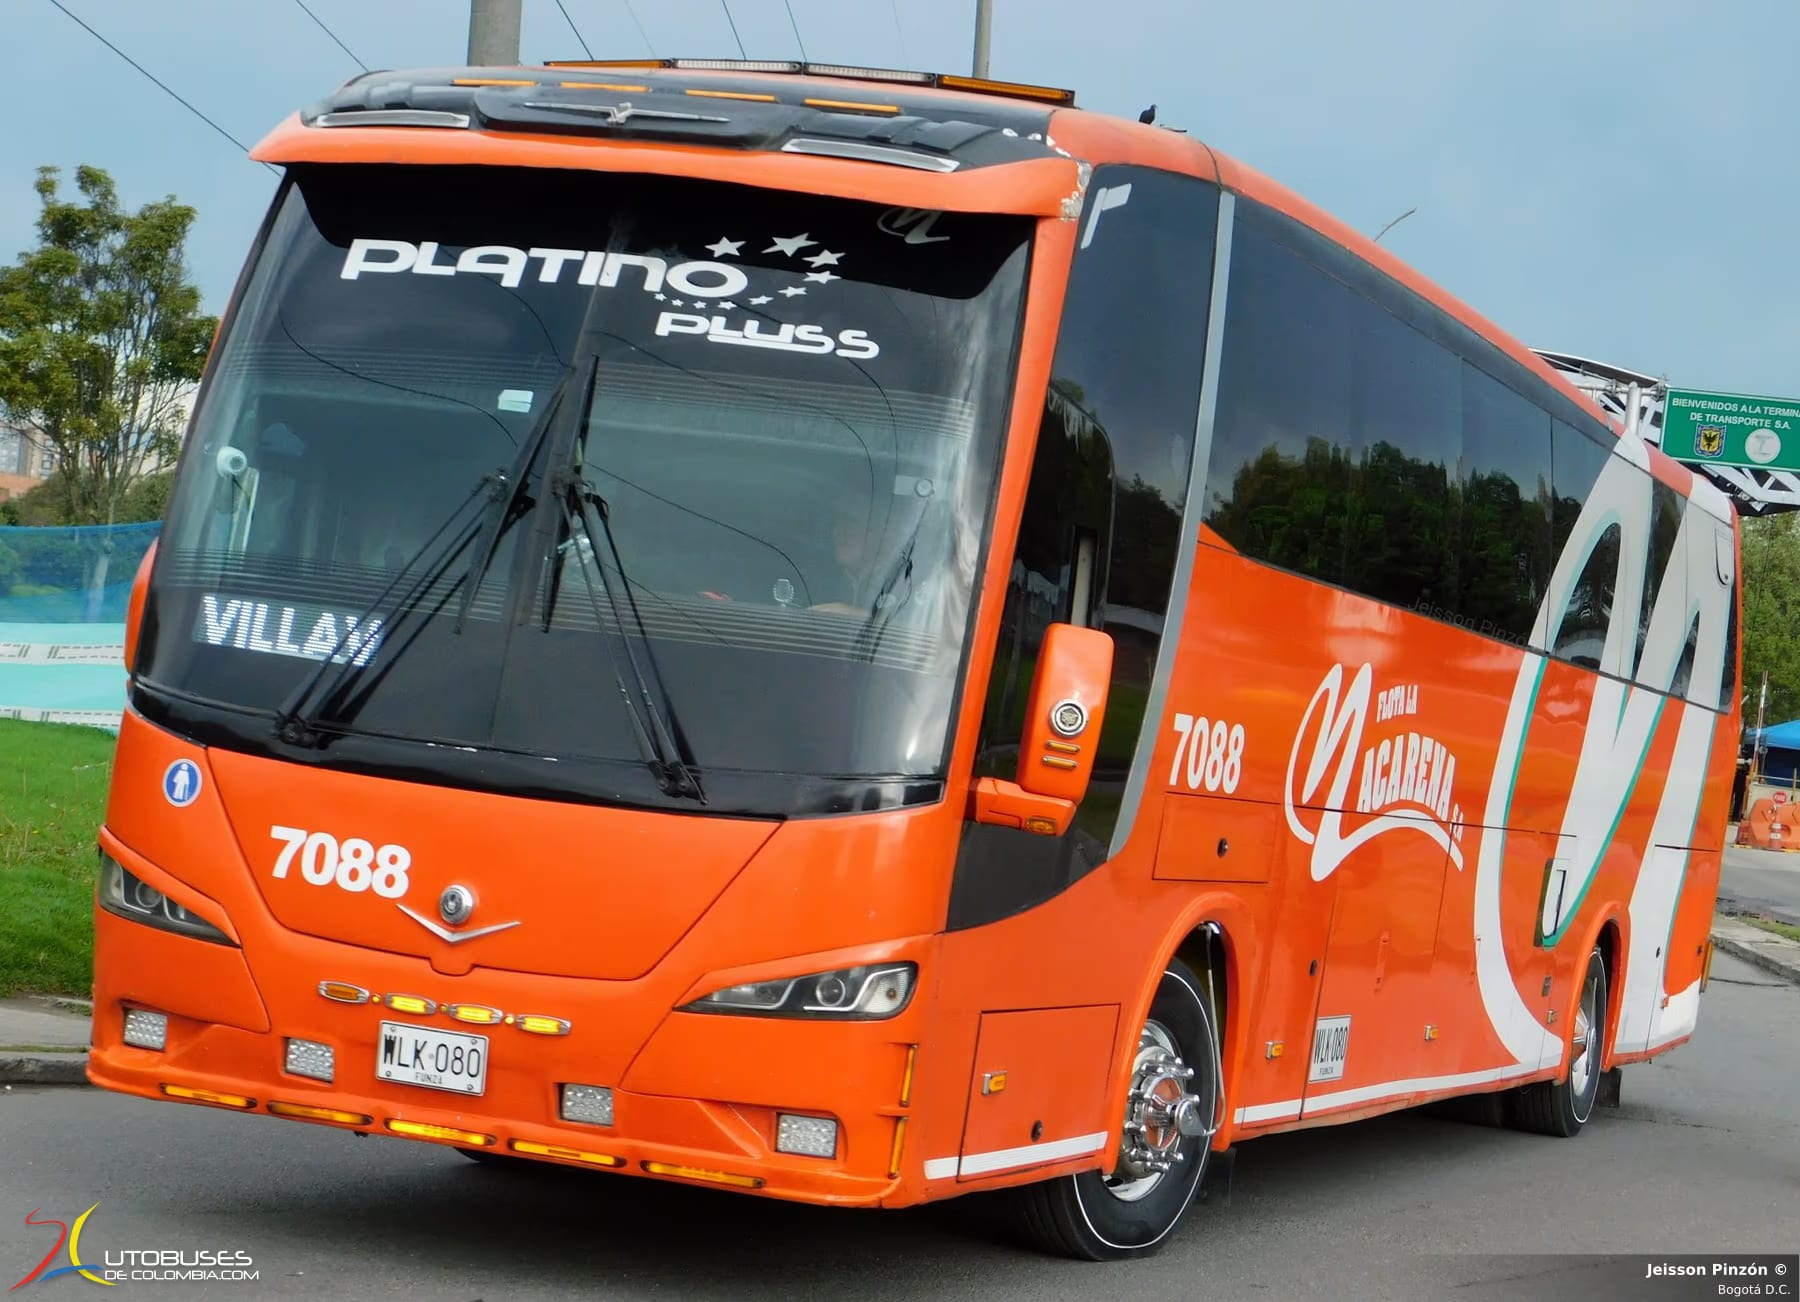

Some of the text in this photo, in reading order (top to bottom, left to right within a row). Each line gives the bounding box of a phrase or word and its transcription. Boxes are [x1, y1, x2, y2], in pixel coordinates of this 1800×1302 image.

[340, 238, 748, 298] PLATINO
[654, 311, 880, 360] PLUSS
[1672, 397, 1739, 412] BIENVENIDOS
[1740, 404, 1748, 413] A
[1748, 405, 1762, 415] LA
[1689, 411, 1704, 422] DE
[1705, 413, 1771, 428] TRANSPORTE
[1376, 684, 1419, 724] FLOTA LA
[1168, 712, 1245, 795] 7088
[270, 825, 412, 899] 7088
